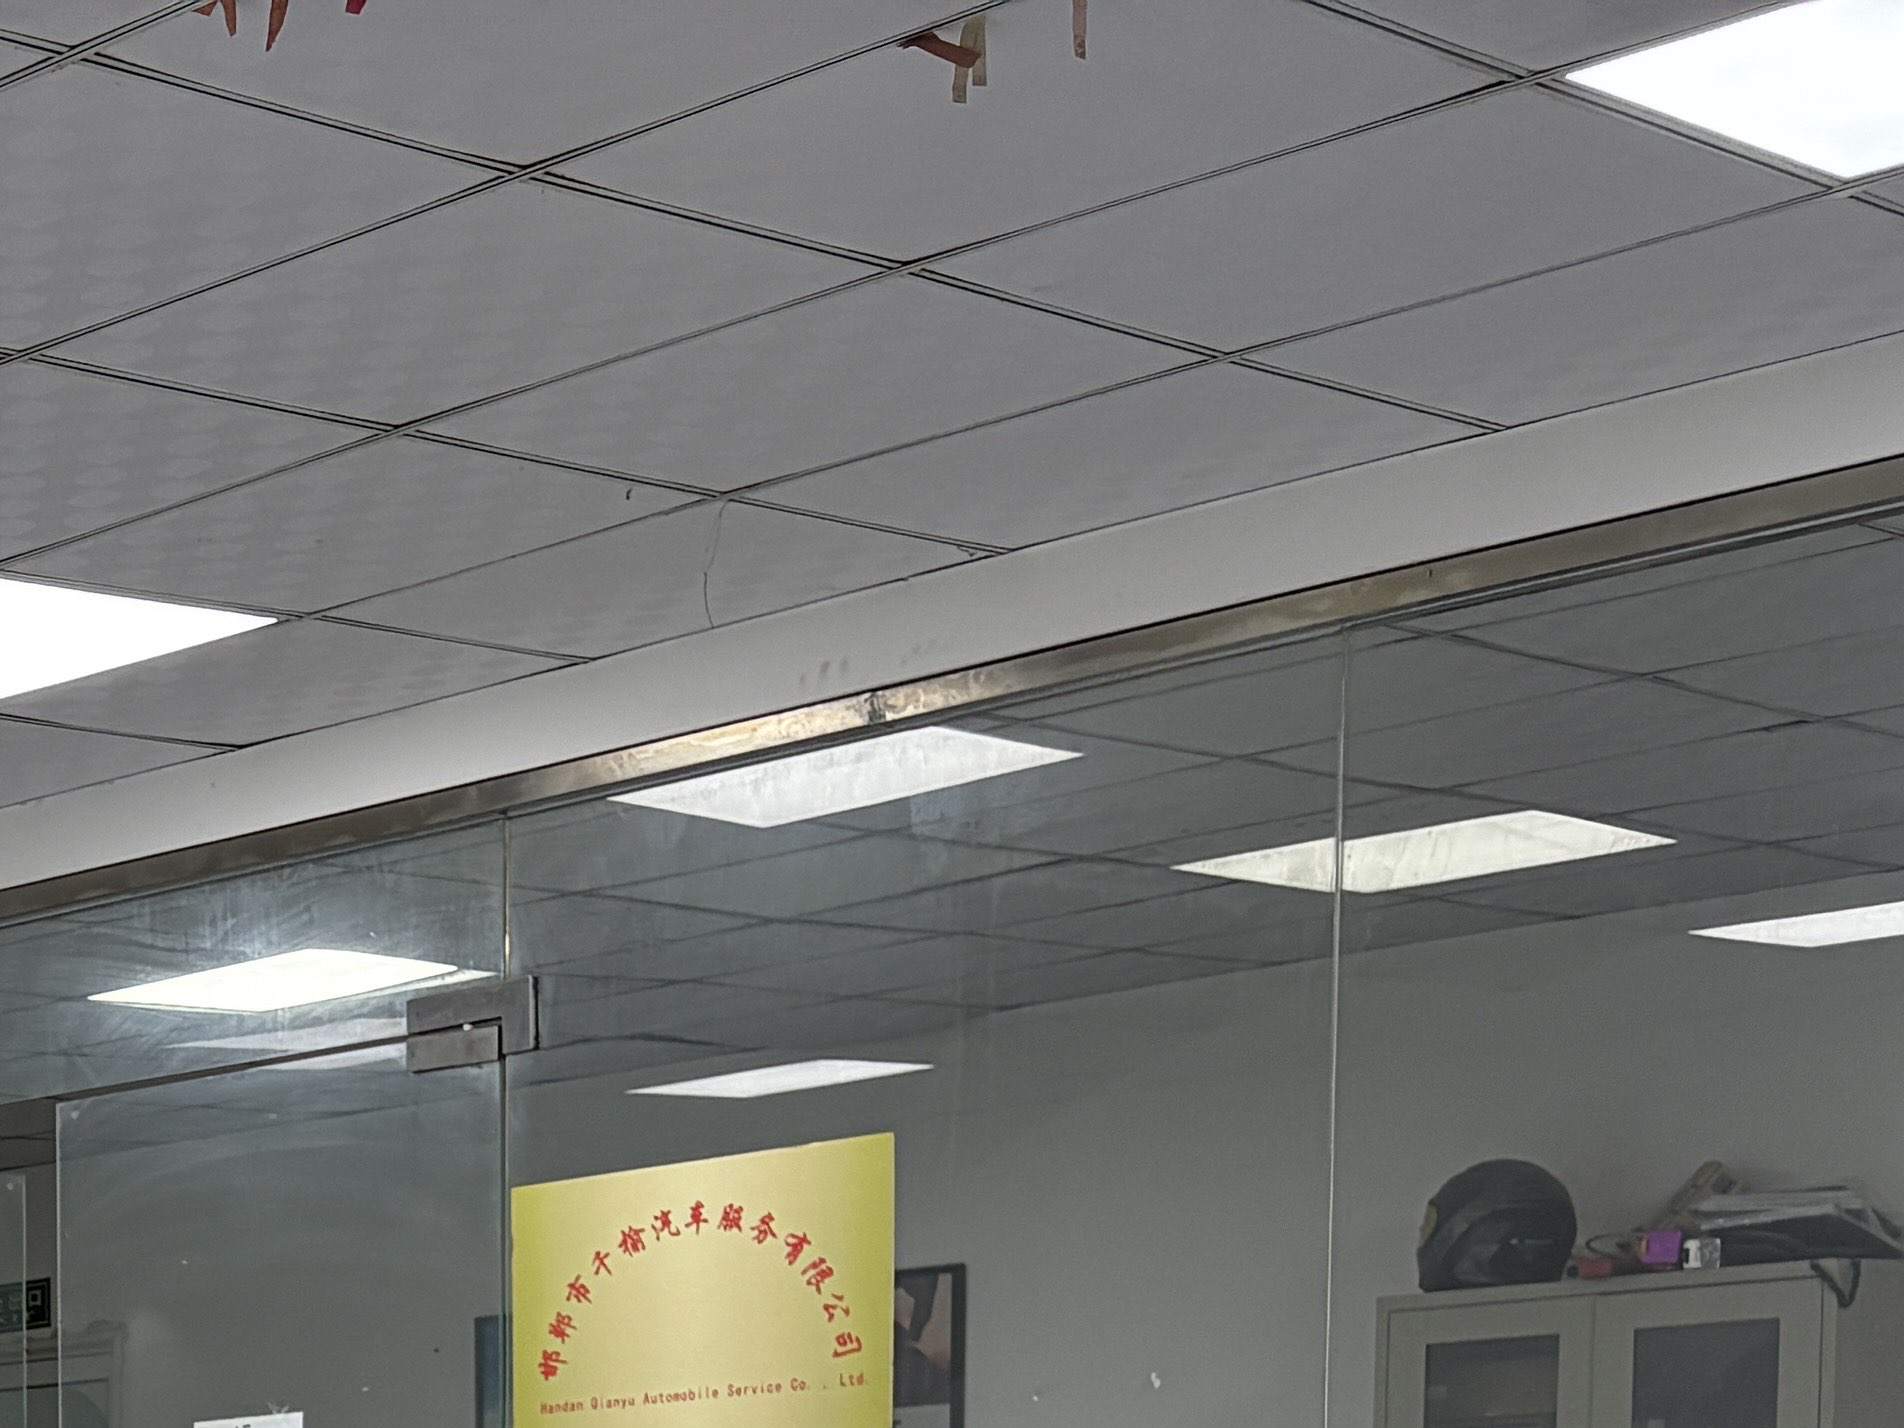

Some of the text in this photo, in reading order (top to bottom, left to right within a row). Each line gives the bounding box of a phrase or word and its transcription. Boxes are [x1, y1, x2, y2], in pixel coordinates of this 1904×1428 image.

[540, 1401, 584, 1415] Handan
[590, 1396, 635, 1410] Qianyu
[642, 1386, 720, 1405] Automobile
[727, 1382, 783, 1398] Service
